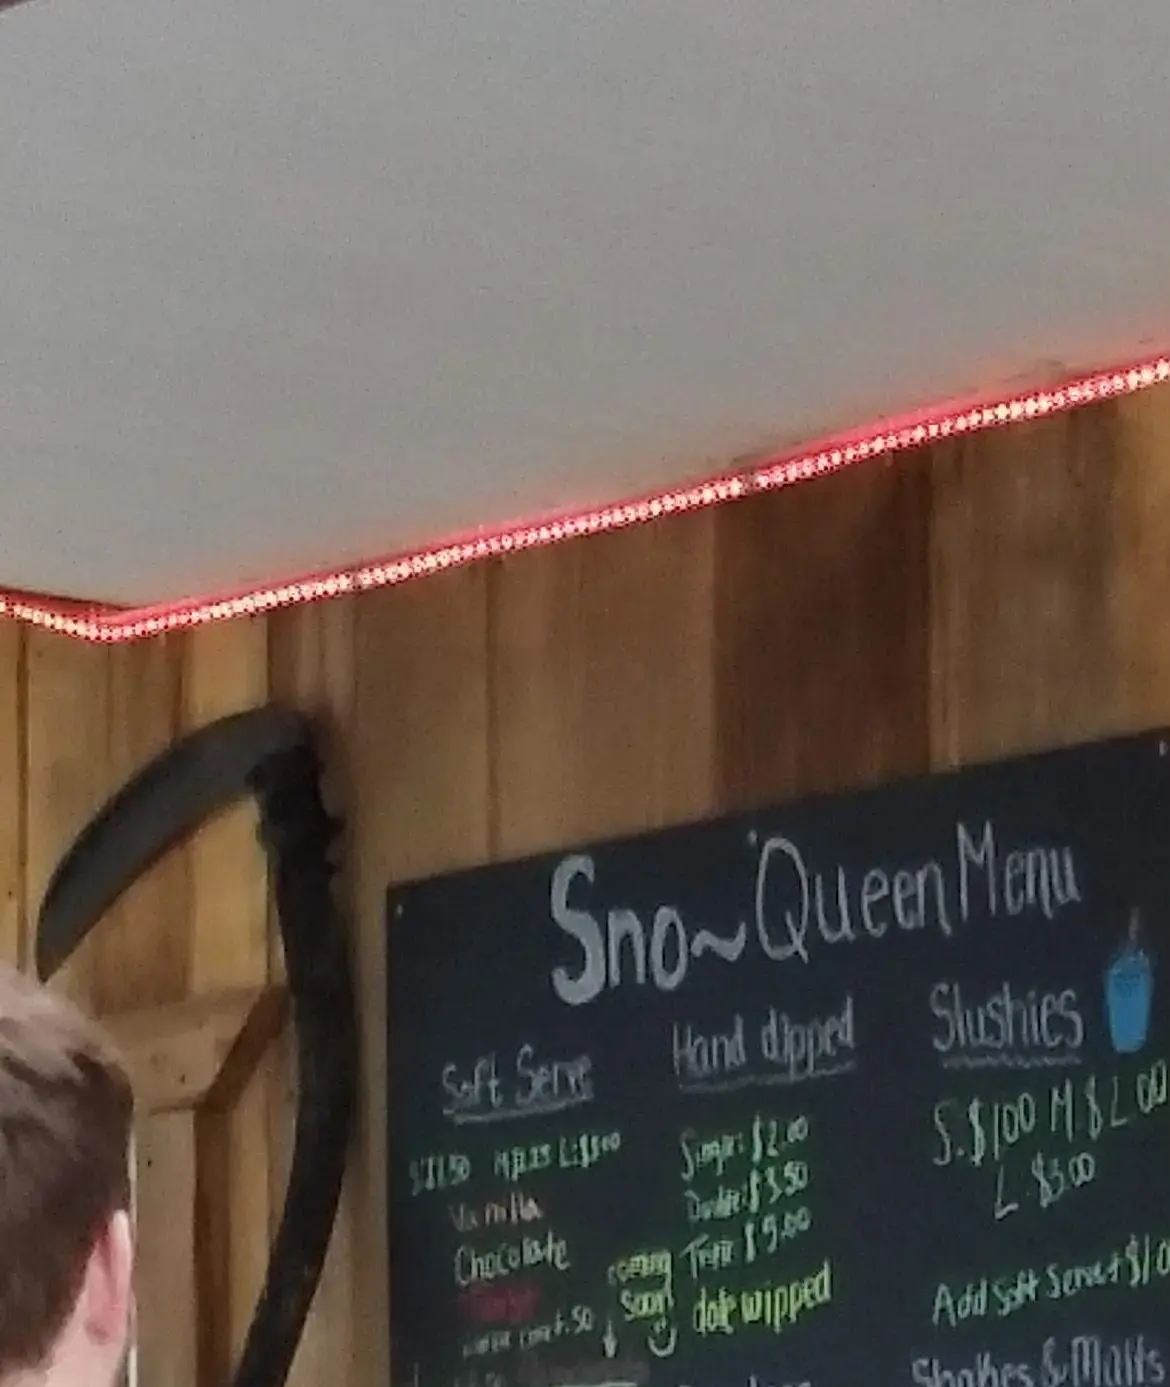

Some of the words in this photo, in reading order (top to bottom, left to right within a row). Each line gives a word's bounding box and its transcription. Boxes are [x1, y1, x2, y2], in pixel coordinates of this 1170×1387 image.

[957, 818, 1082, 922] Menu
[672, 1017, 746, 1076] Hand
[761, 996, 856, 1082] dipped
[930, 978, 1085, 1052] Slushies
[441, 1052, 504, 1110] Soft
[453, 1228, 571, 1286] Chocolate
[931, 1276, 989, 1328] Add
